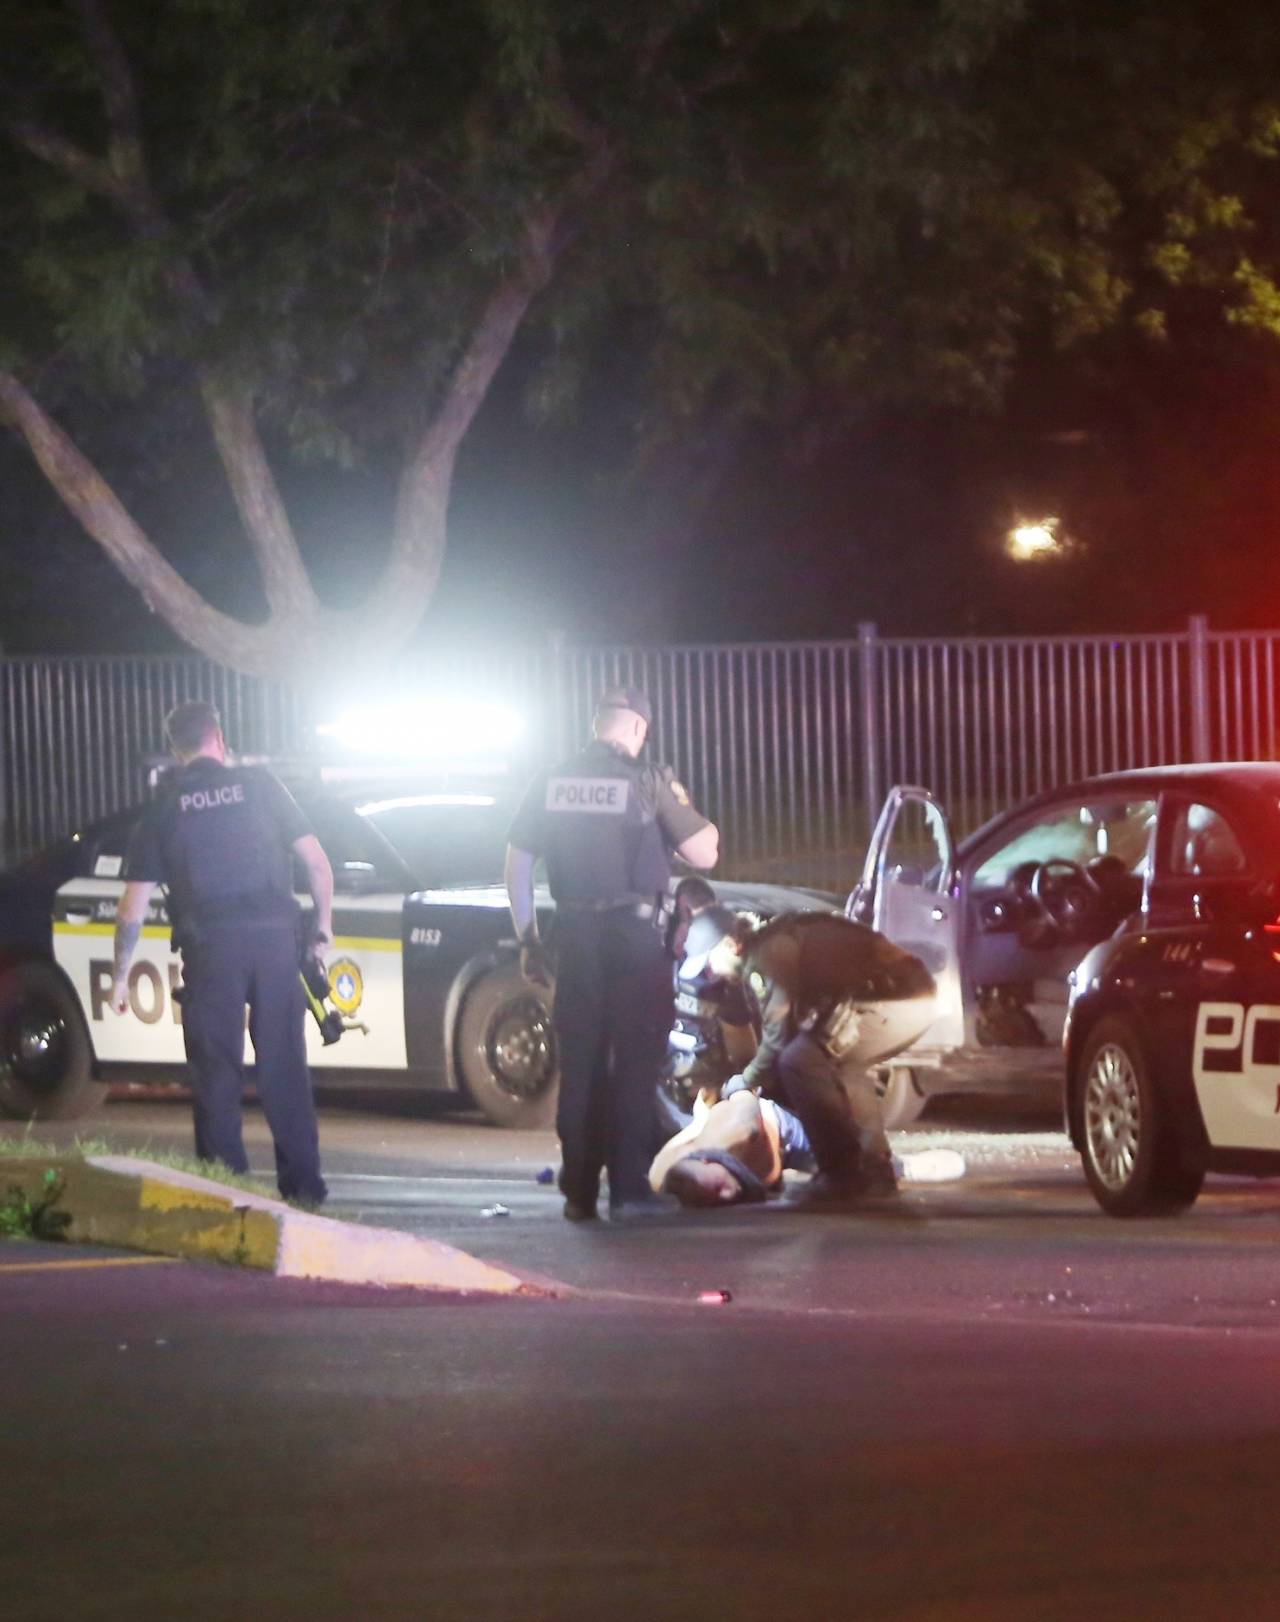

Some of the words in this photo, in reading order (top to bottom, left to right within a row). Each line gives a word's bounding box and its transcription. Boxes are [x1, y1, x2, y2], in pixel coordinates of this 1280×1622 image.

[180, 784, 244, 811] POLICE
[555, 785, 617, 805] POLICE
[410, 927, 442, 946] 8153
